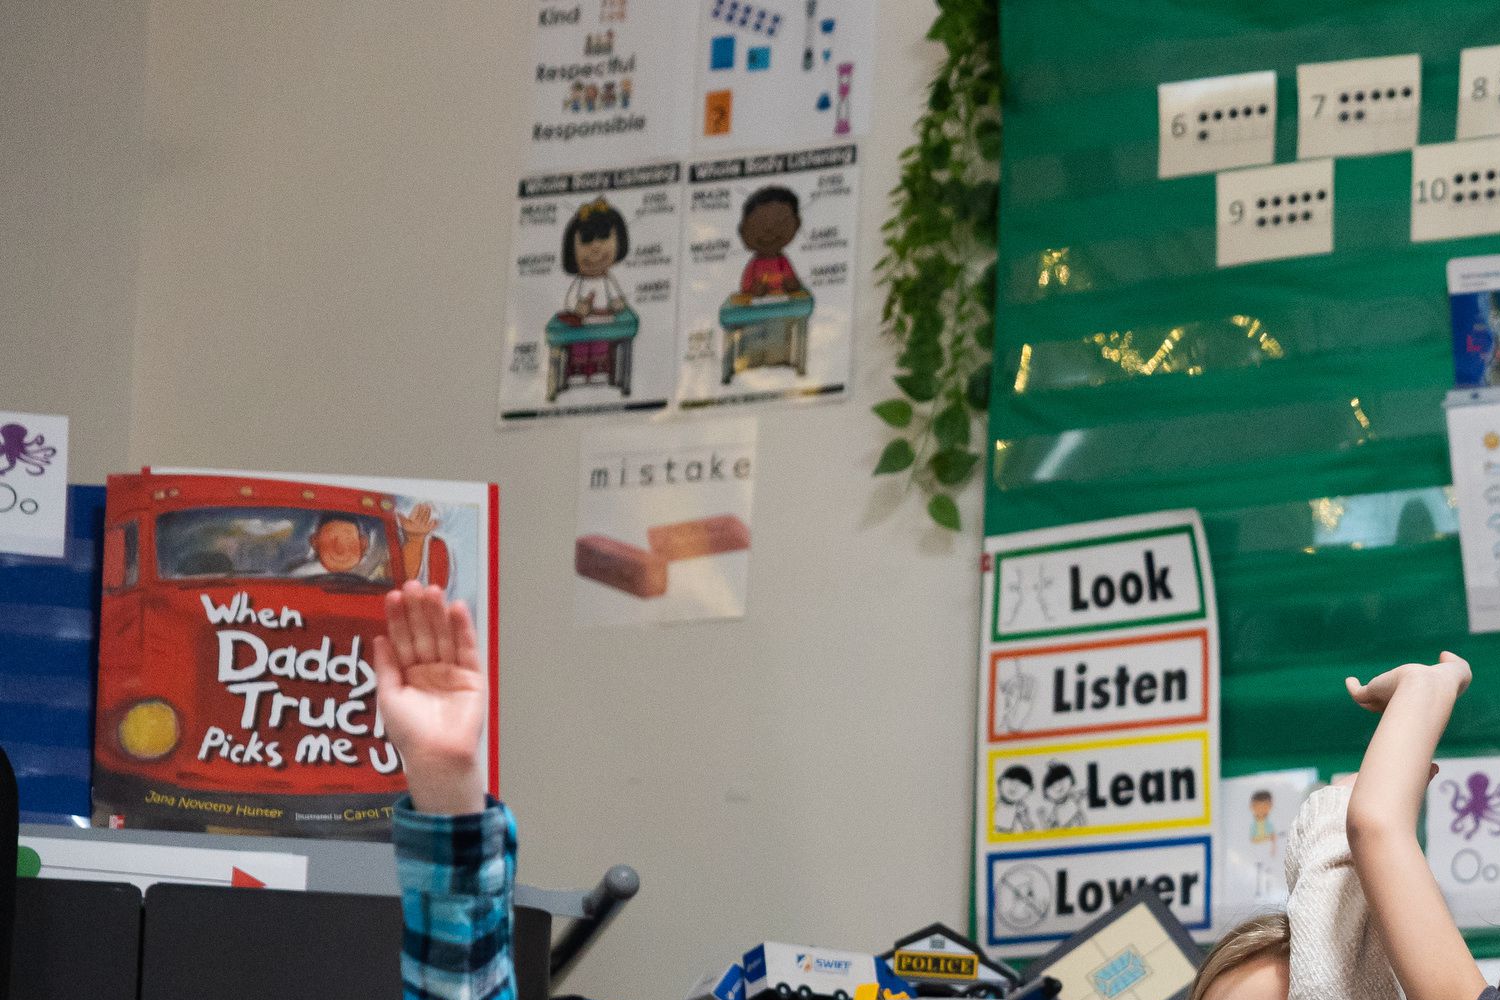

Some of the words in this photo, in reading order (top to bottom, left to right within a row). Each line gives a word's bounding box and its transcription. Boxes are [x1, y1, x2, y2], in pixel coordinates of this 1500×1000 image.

[538, 5, 580, 27] Kind
[535, 52, 637, 82] Respectful
[1471, 77, 1487, 100] 8
[1311, 95, 1327, 118] 7
[532, 114, 646, 142] Responsible
[1170, 113, 1187, 138] 6
[1416, 176, 1447, 203] 10
[1228, 202, 1244, 225] 9
[590, 452, 751, 490] mistake
[1069, 550, 1174, 612] Look
[201, 591, 303, 629] When
[1053, 664, 1189, 714] Listen
[197, 726, 283, 767] Picks
[295, 733, 358, 764] me
[1086, 761, 1197, 808] Lean
[144, 790, 176, 807] Jana
[236, 803, 283, 818] Hunter
[901, 956, 975, 976] POLICE
